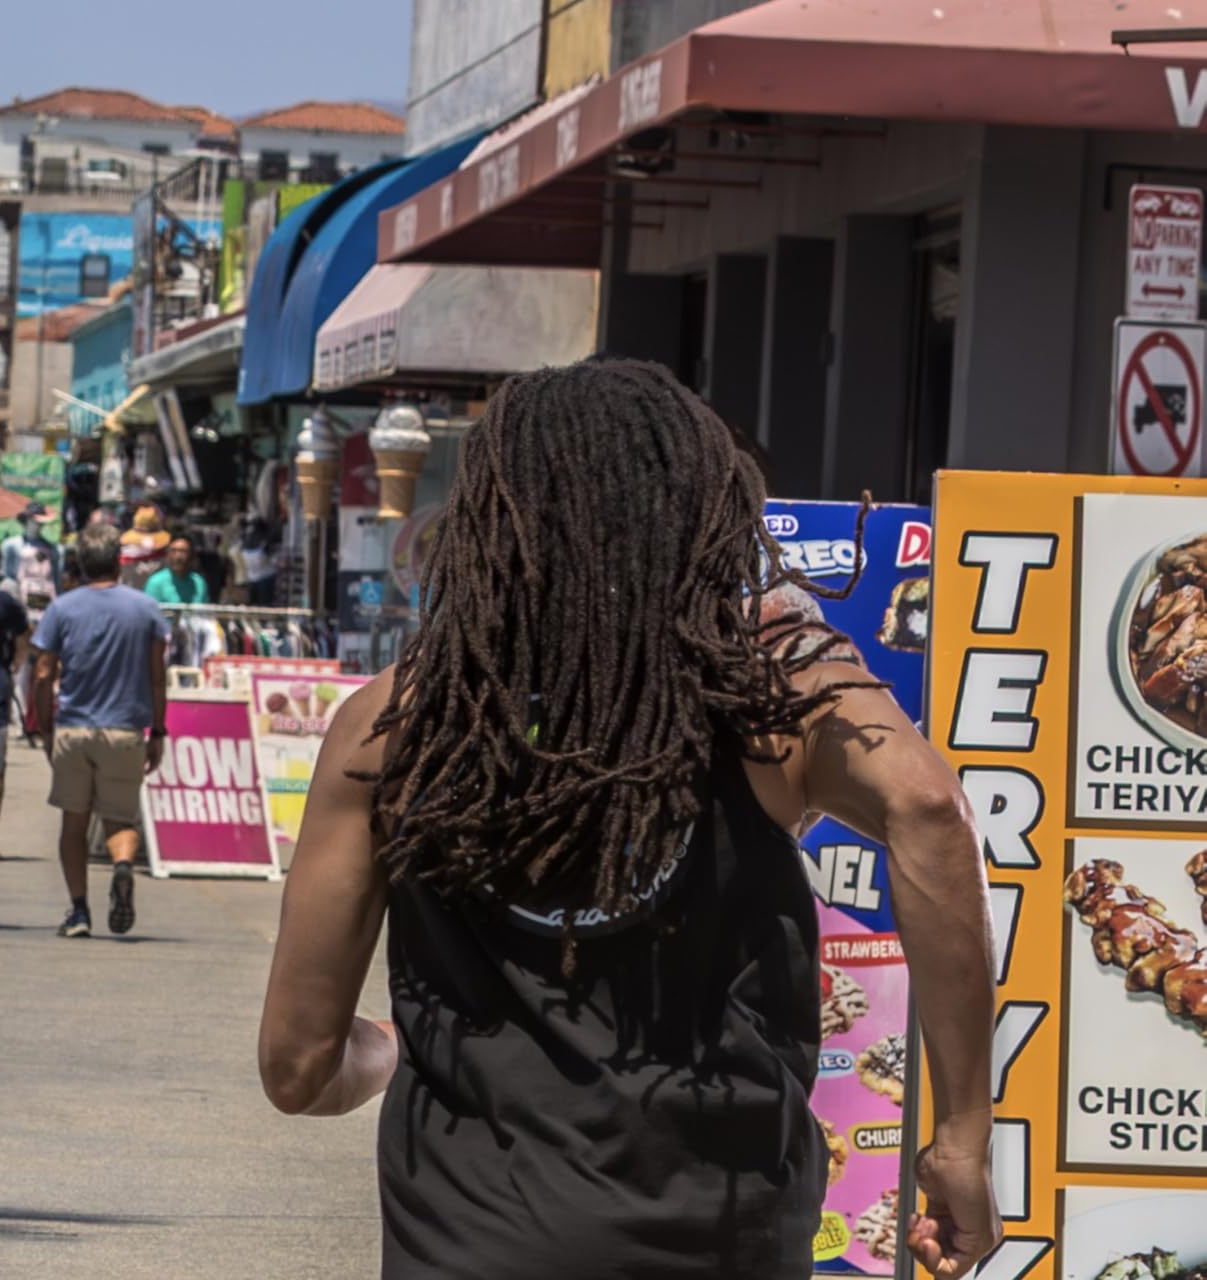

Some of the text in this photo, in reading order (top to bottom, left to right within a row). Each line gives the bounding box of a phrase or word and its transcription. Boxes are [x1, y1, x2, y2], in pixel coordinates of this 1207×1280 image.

[1132, 216, 1155, 248] NO
[1134, 255, 1196, 279] ANY TIME
[766, 516, 797, 534] ED
[776, 540, 866, 576] REO
[897, 521, 932, 566] D
[152, 788, 262, 825] HIRING
[801, 845, 881, 911] NEL
[1078, 1086, 1202, 1117] CHICK
[856, 1127, 902, 1148] CHUR
[1109, 1121, 1207, 1152] STIC
